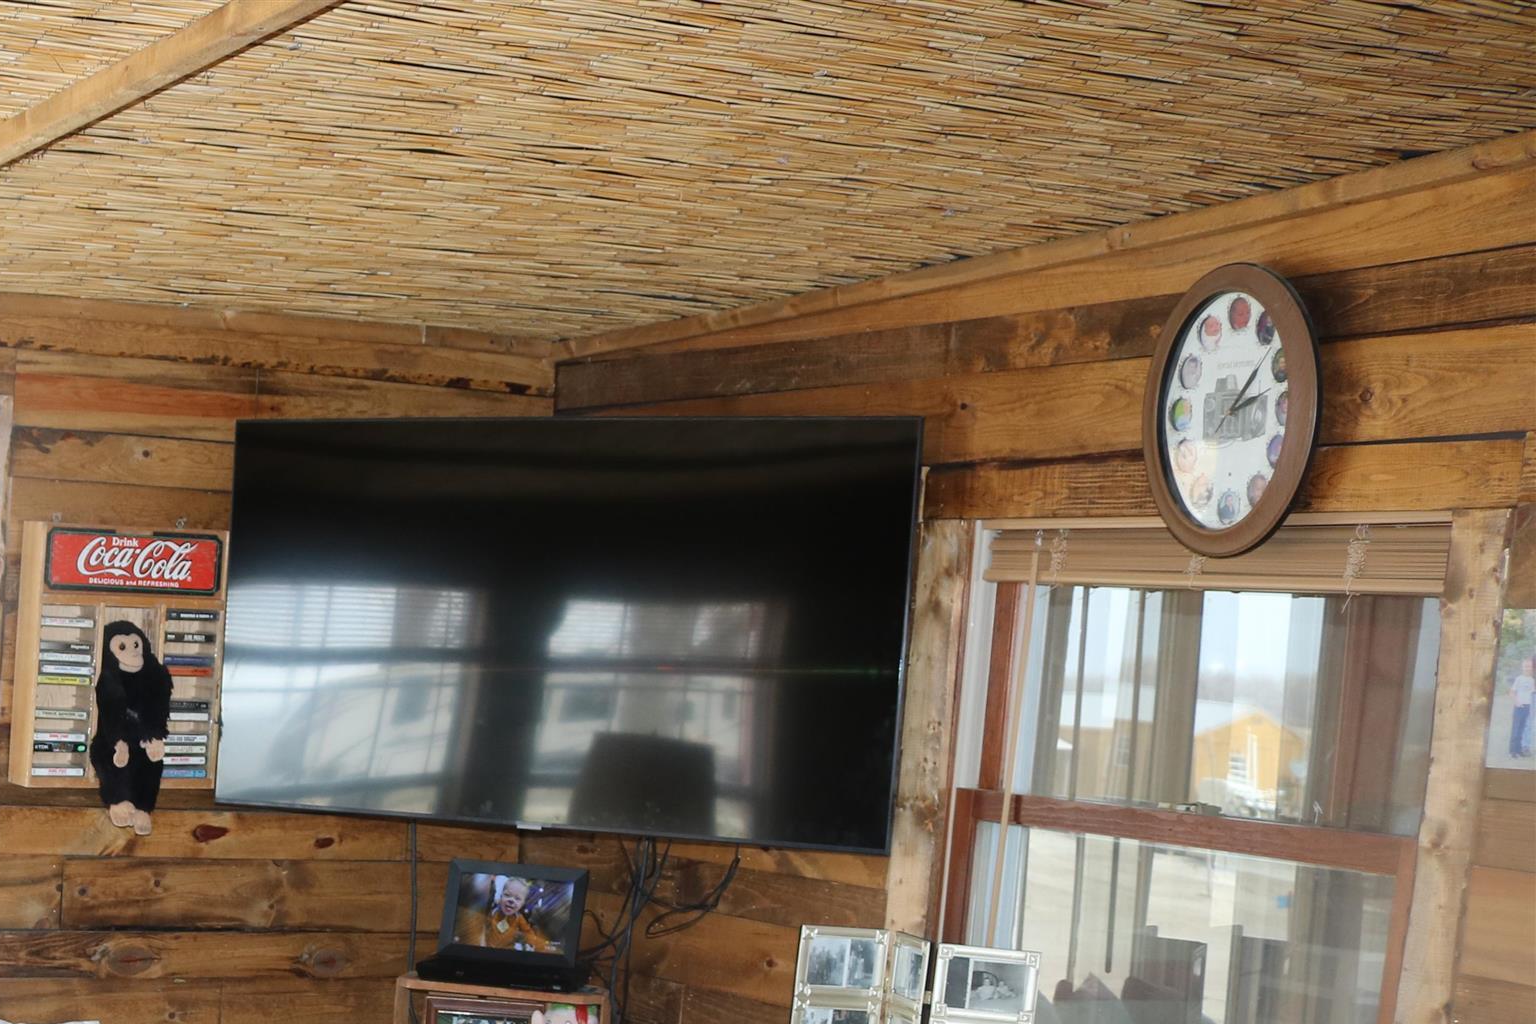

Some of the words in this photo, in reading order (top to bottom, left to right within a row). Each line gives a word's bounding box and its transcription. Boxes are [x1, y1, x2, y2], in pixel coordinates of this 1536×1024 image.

[112, 537, 139, 547] Drink
[77, 536, 198, 580] Coca-Cola
[89, 577, 124, 586] DELICIOUS
[138, 580, 180, 588] REFRESHING
